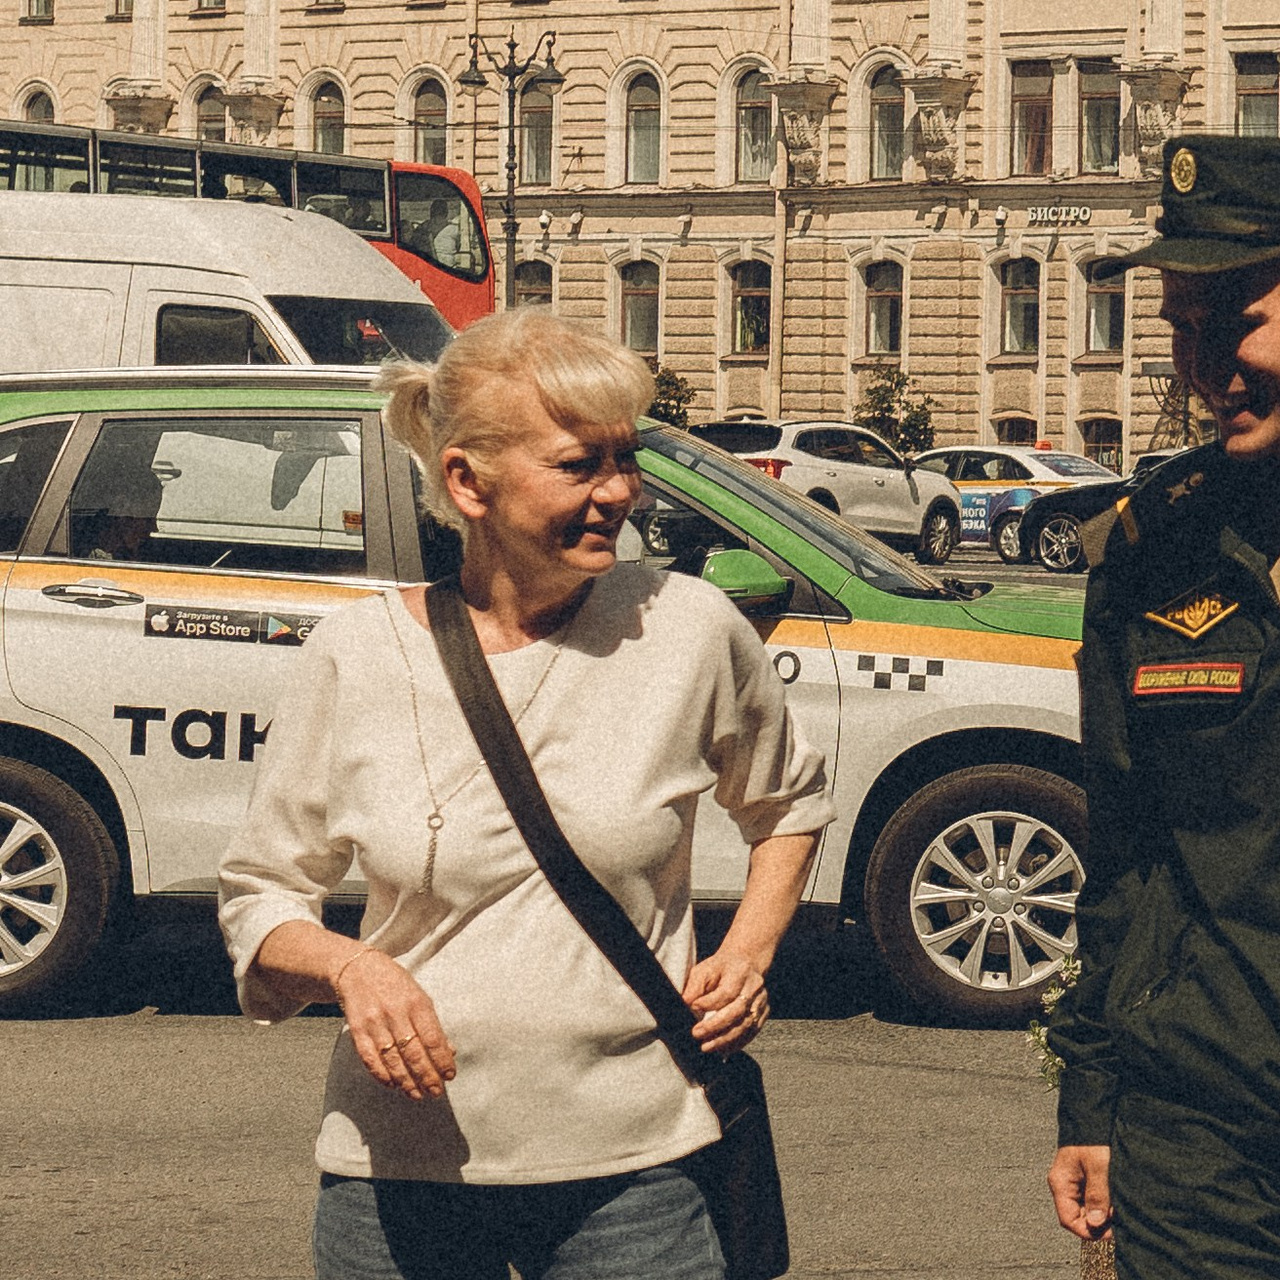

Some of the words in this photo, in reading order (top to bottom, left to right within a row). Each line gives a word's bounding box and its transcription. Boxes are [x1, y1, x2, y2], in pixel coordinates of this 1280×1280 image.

[1027, 206, 1092, 221] БИСТРО
[175, 619, 207, 636] App
[209, 621, 251, 637] Store
